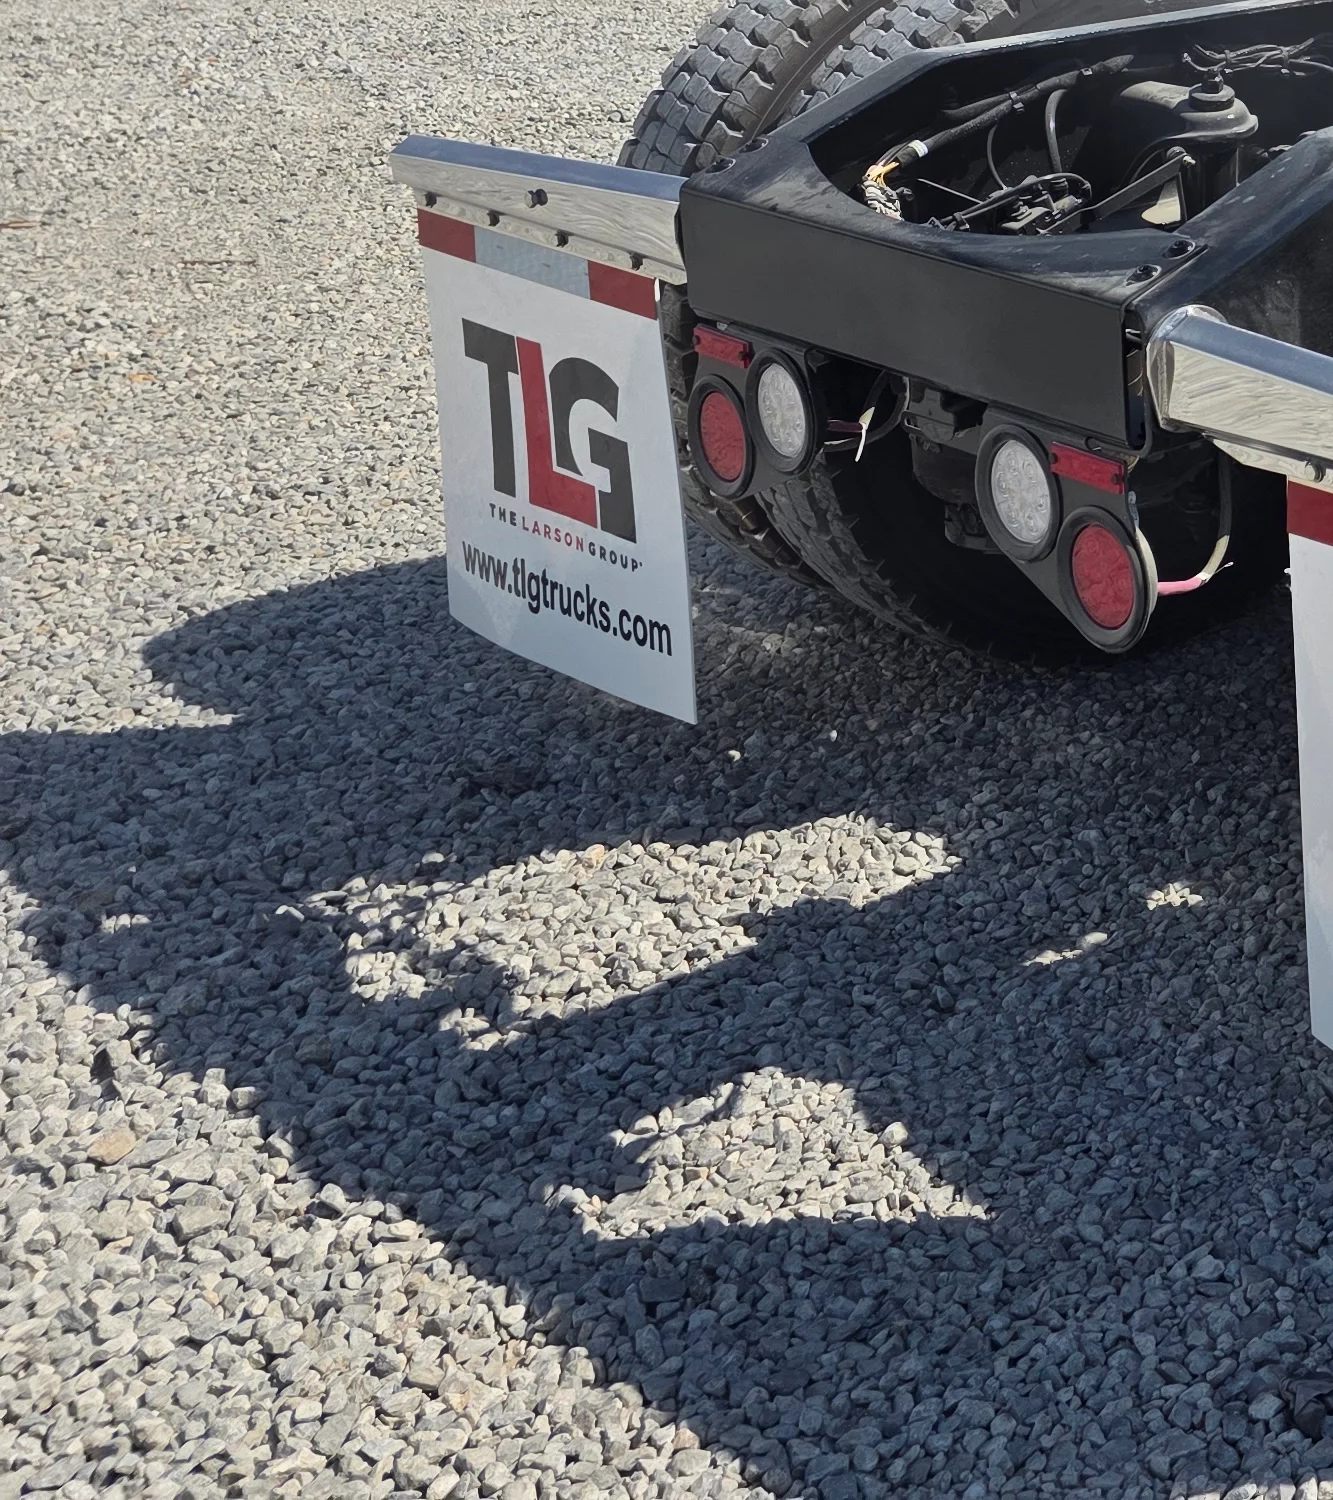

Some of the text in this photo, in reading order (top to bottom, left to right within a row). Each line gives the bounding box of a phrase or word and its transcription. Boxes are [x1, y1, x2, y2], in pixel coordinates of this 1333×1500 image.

[461, 318, 638, 544] TLG
[489, 503, 640, 573] THE LARSON GROUP
[461, 541, 673, 657] www.tlgtrucks.com
